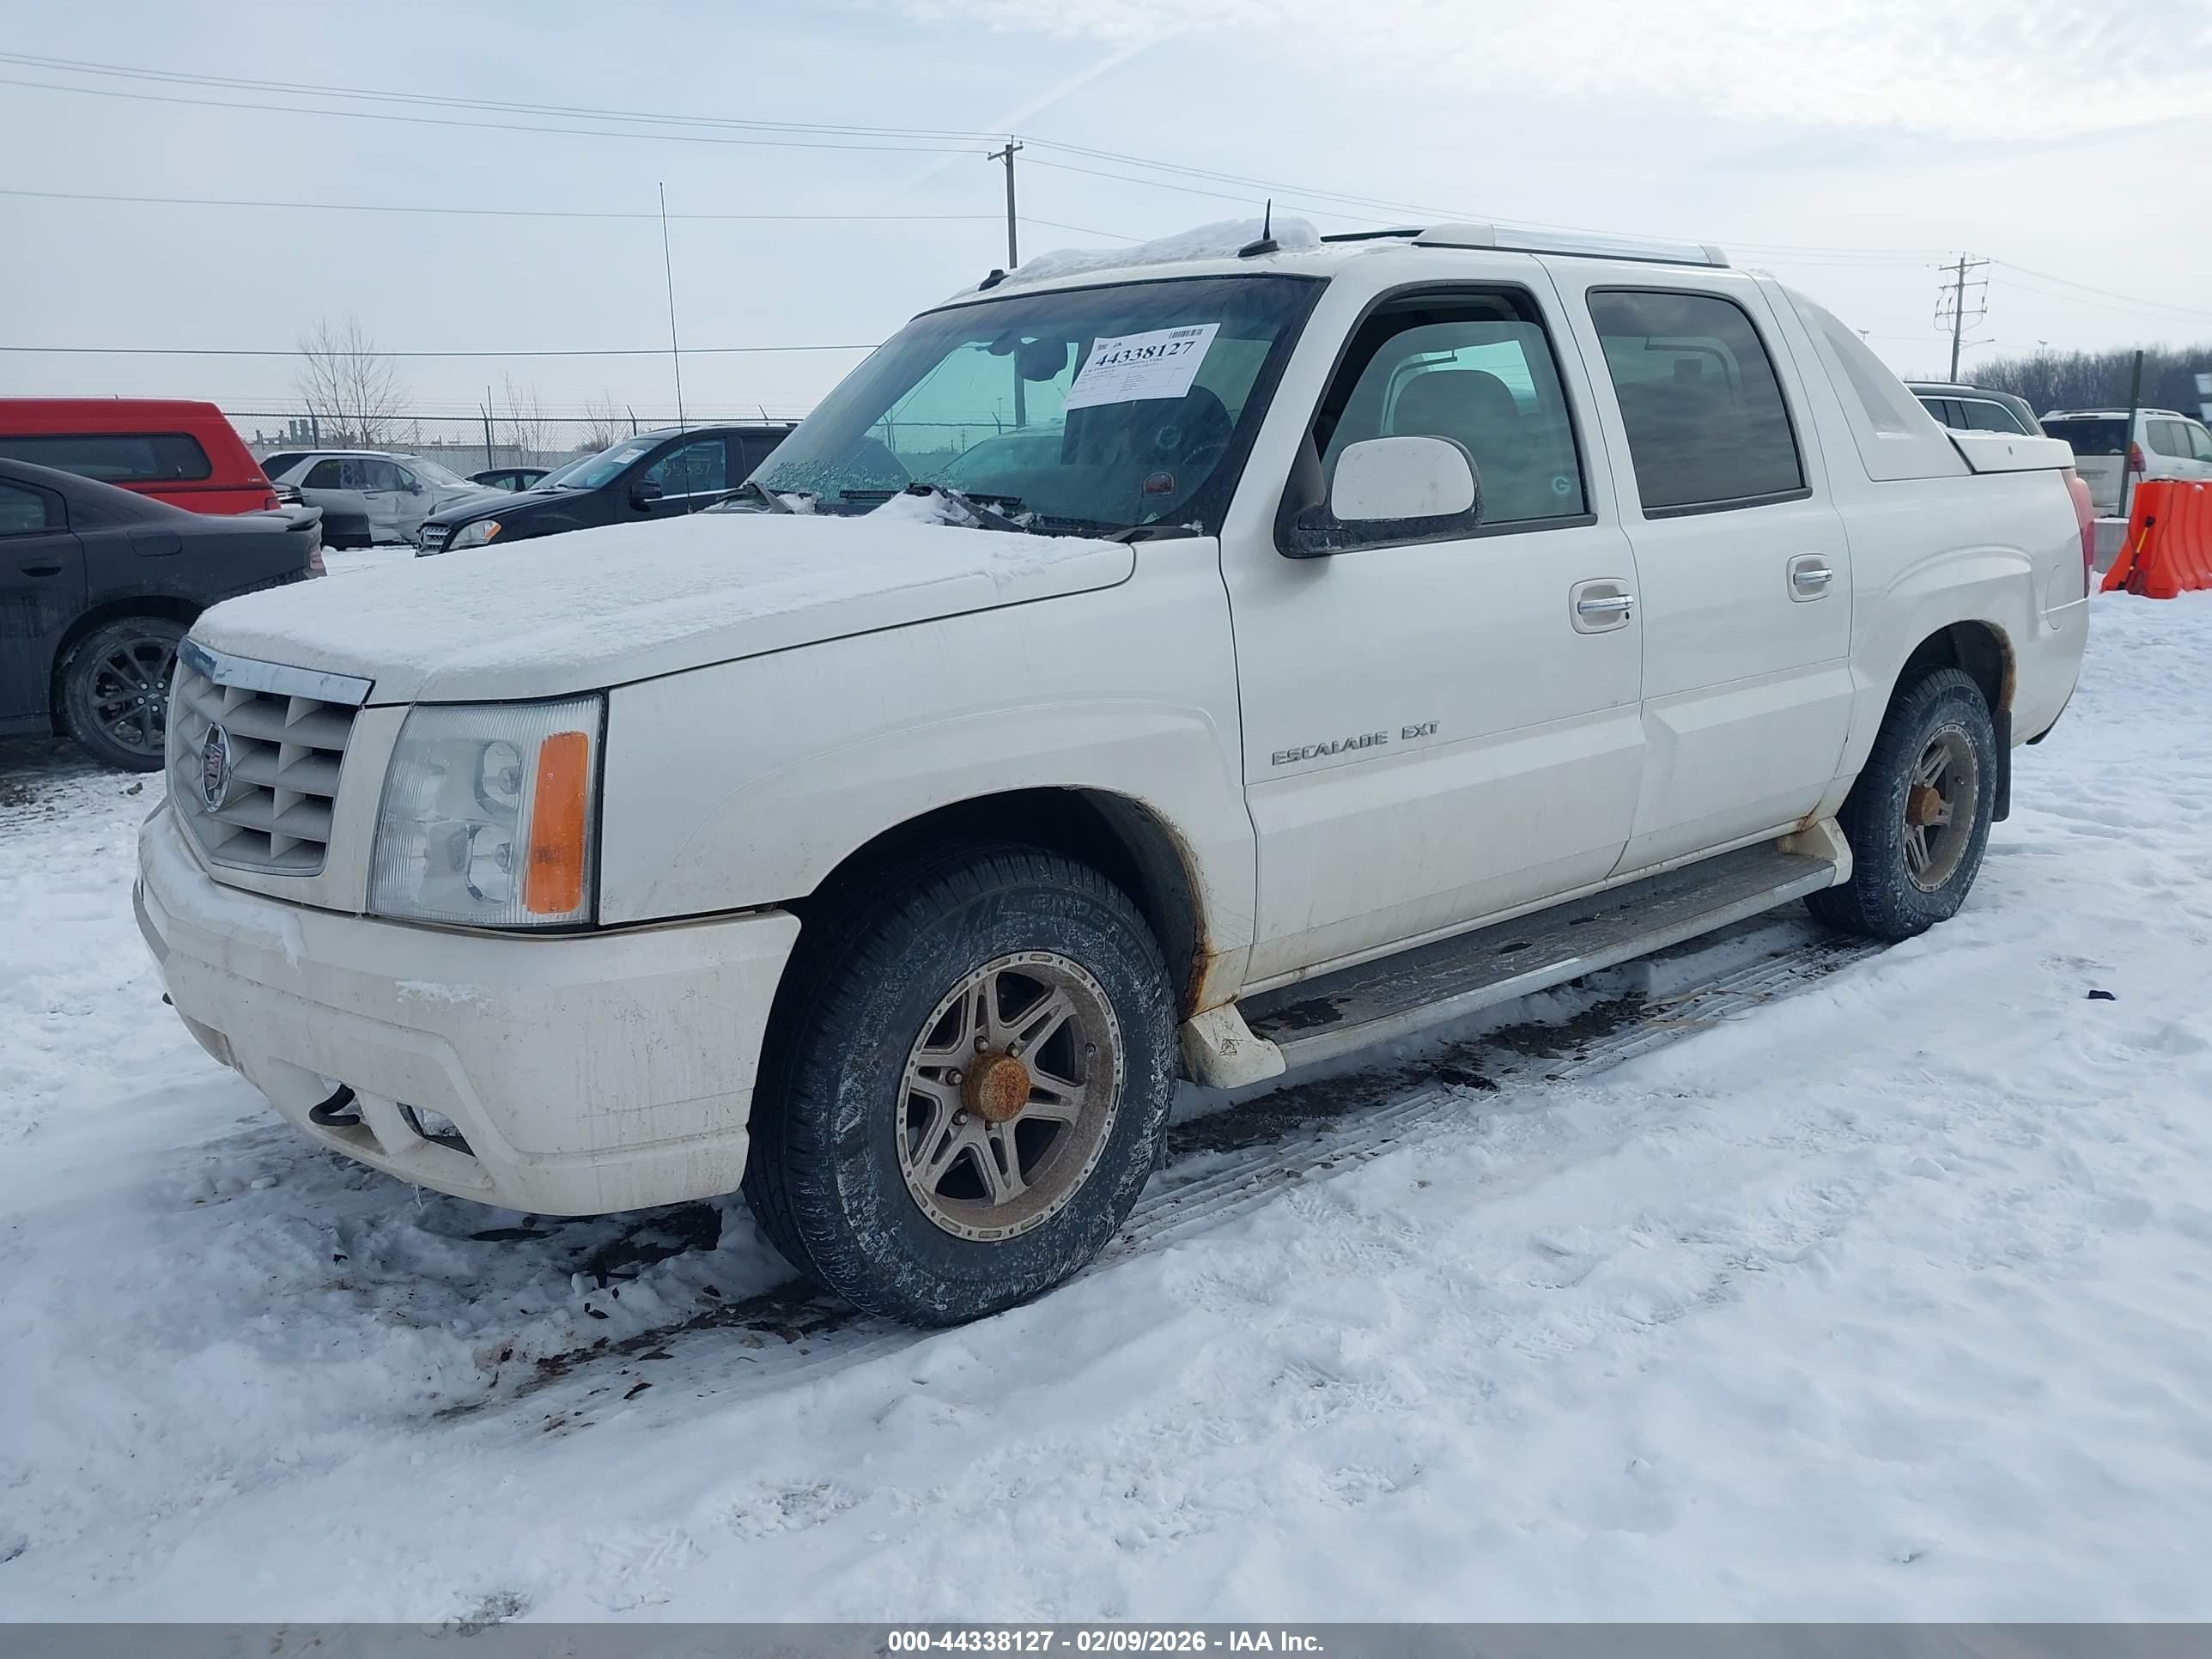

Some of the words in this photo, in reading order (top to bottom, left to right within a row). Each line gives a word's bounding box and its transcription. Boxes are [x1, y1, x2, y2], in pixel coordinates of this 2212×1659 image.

[1095, 341, 1196, 367] 44338127
[1552, 475, 1571, 495] G
[1272, 731, 1389, 766] ESCALADE
[1401, 720, 1441, 739] EXT
